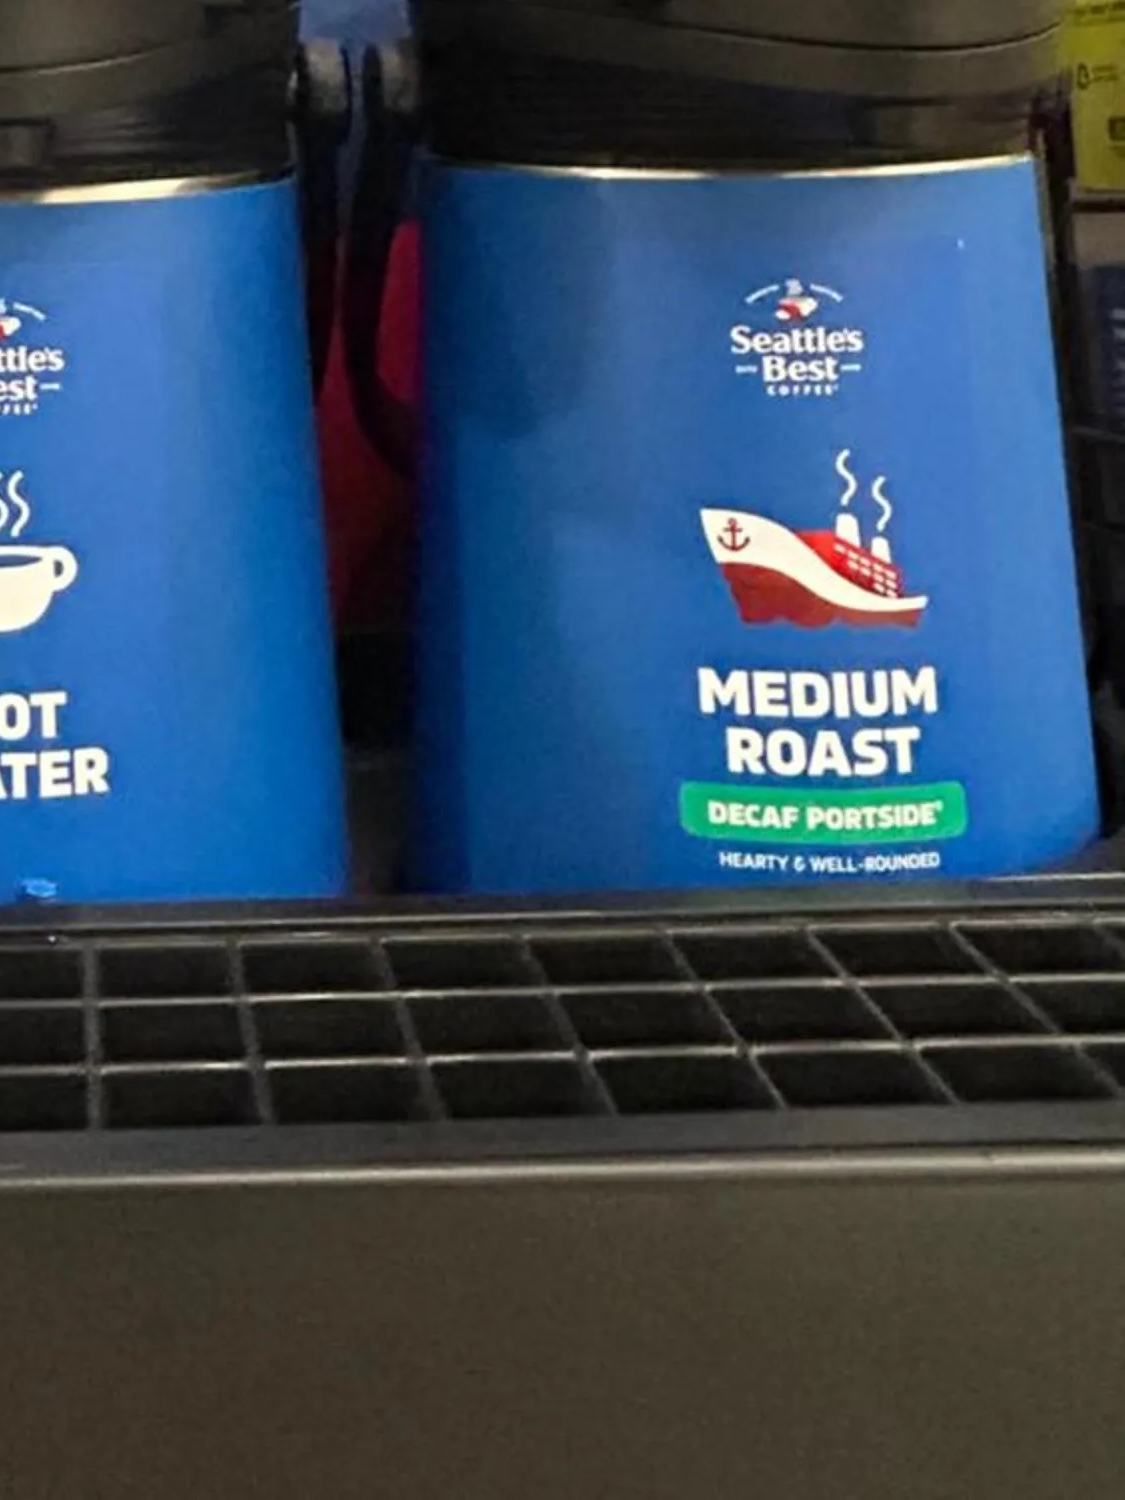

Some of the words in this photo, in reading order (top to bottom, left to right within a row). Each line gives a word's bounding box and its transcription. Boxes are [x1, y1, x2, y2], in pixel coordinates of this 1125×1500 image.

[730, 325, 865, 354] Seattle's
[762, 355, 839, 383] Best
[698, 666, 939, 719] MEDIUM
[725, 726, 923, 779] ROAST
[707, 799, 800, 830] DECAF
[718, 851, 790, 871] HEARTY
[810, 850, 942, 873] WELL-ROUNDED
